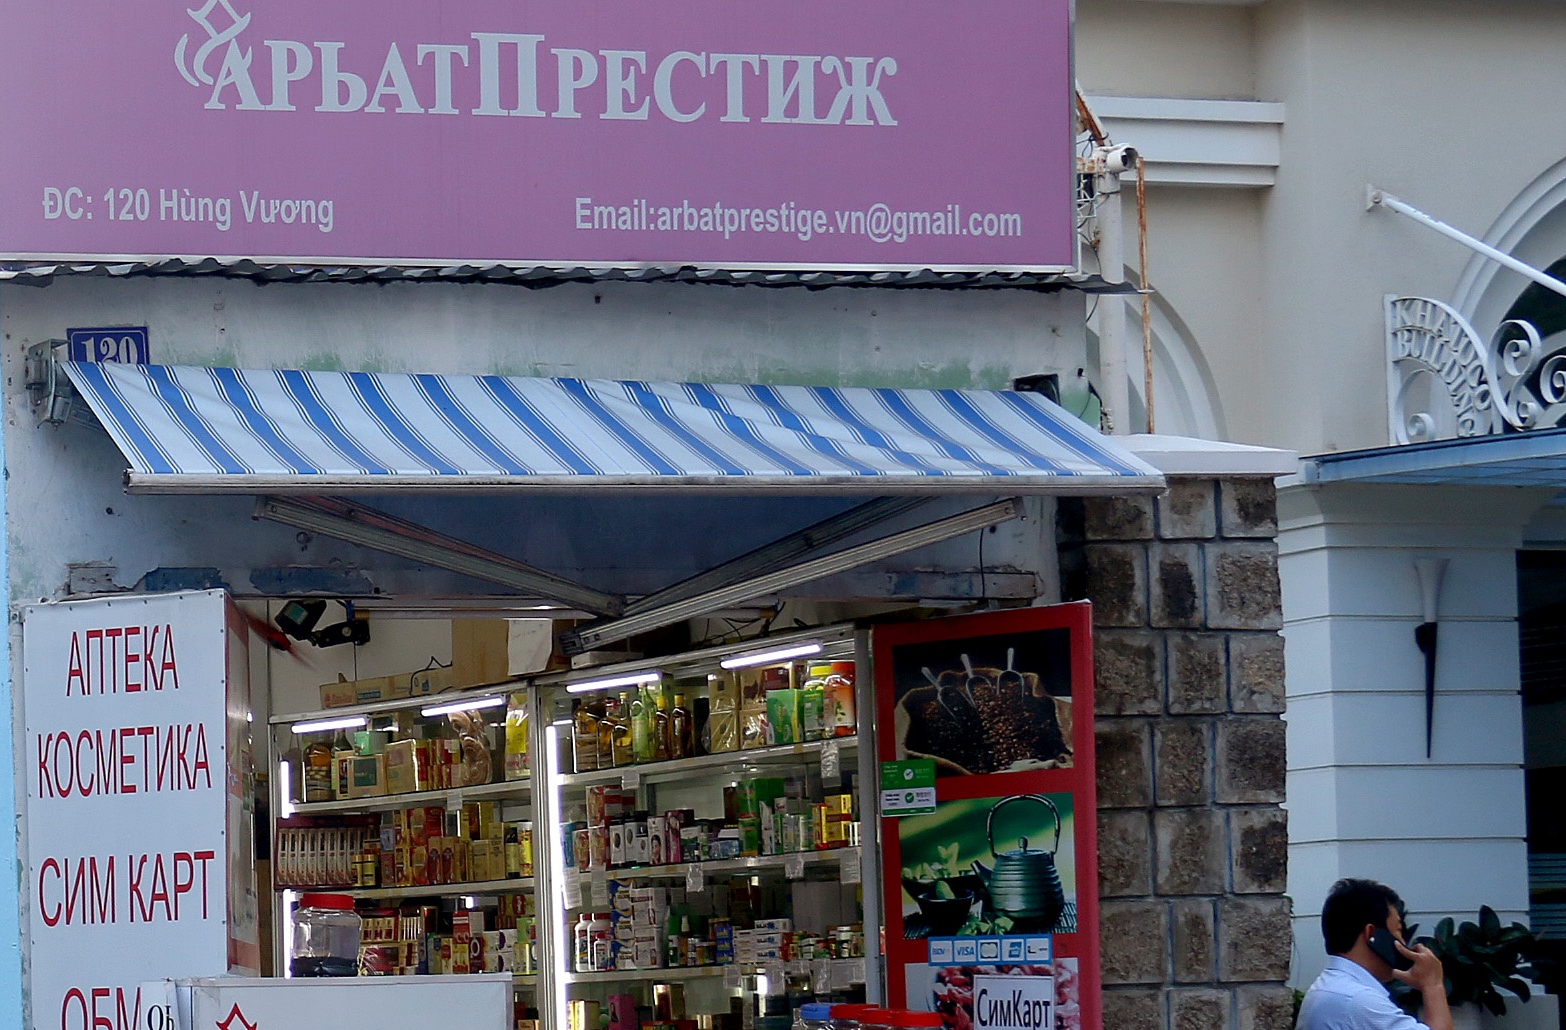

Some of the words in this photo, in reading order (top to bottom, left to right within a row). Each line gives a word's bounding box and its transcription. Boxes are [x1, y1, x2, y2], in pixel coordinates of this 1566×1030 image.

[42, 186, 93, 220] ĐC:
[104, 187, 151, 221] 120
[159, 188, 232, 231] Hùng
[239, 190, 334, 233] Vương
[574, 197, 1023, 243] Email:arbatprestige.vn@gmail.com
[80, 336, 139, 365] 120
[1392, 328, 1476, 438] BUILDING
[66, 624, 180, 697] АПТЕКА
[37, 723, 212, 799] КОСМЕТИКА
[38, 856, 116, 927] СИМ
[128, 850, 215, 923] КАРТ
[957, 946, 974, 956] VISA
